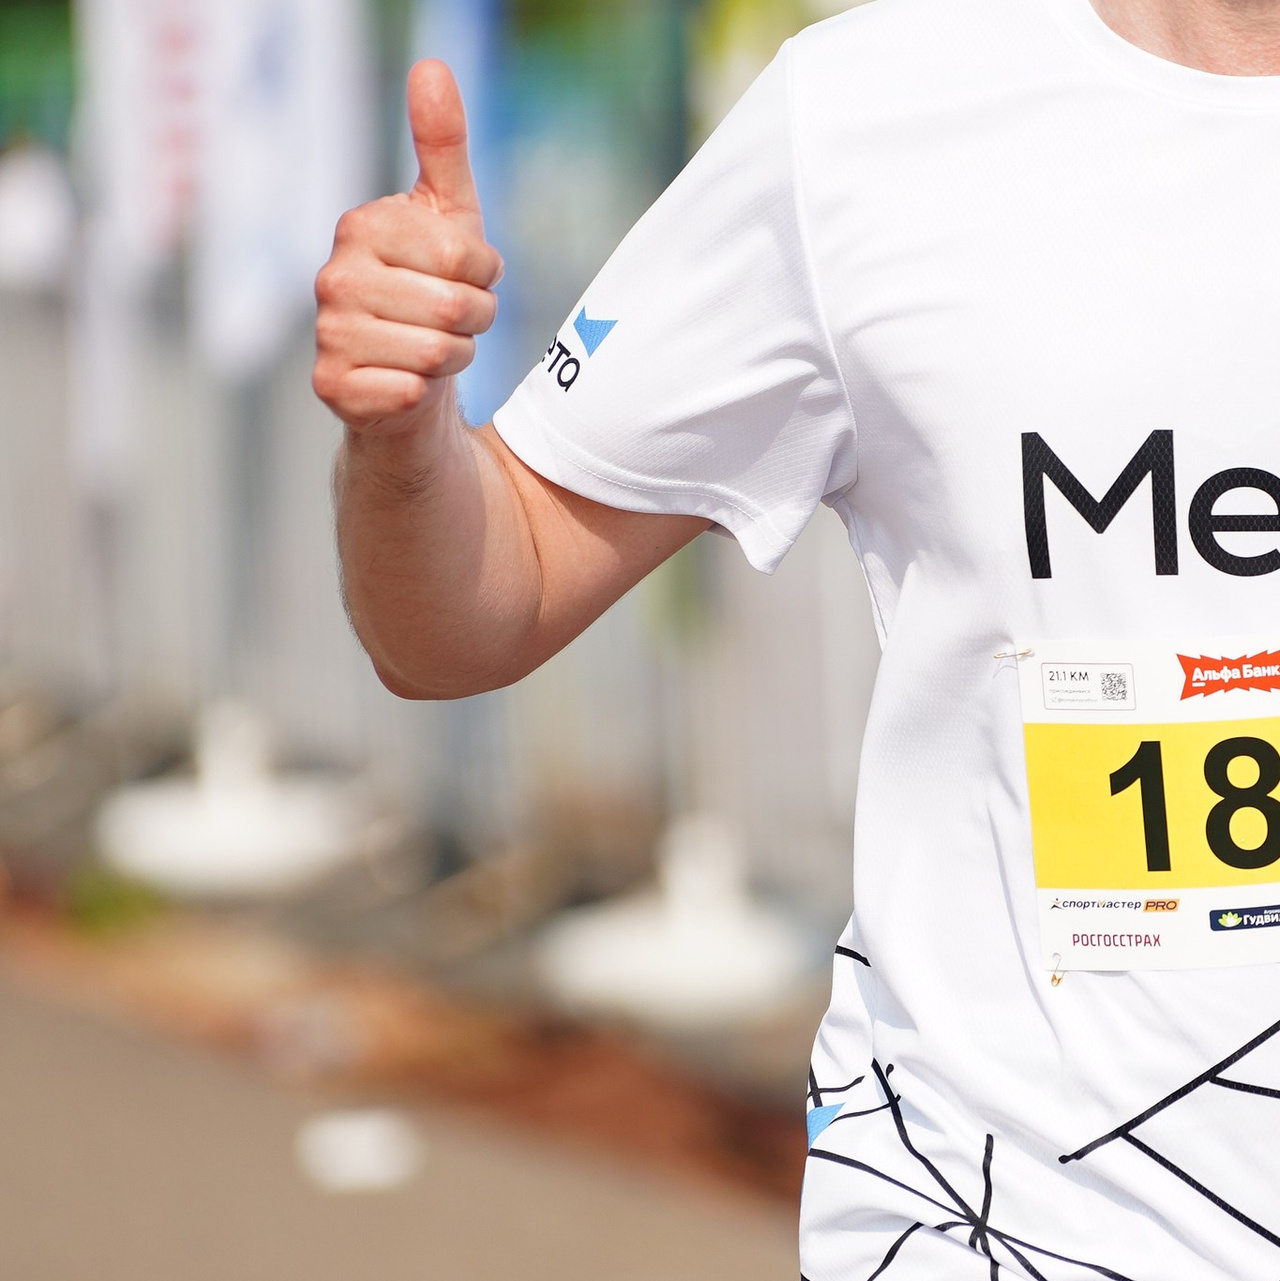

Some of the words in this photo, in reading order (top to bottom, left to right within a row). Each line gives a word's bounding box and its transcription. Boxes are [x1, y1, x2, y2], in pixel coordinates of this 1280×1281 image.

[1049, 671, 1067, 681] 21.1
[1191, 665, 1241, 687] Альфа
[1242, 664, 1280, 678] Банк
[1145, 901, 1178, 910] PRO
[1072, 933, 1161, 947] РОСГОССТРАХ
